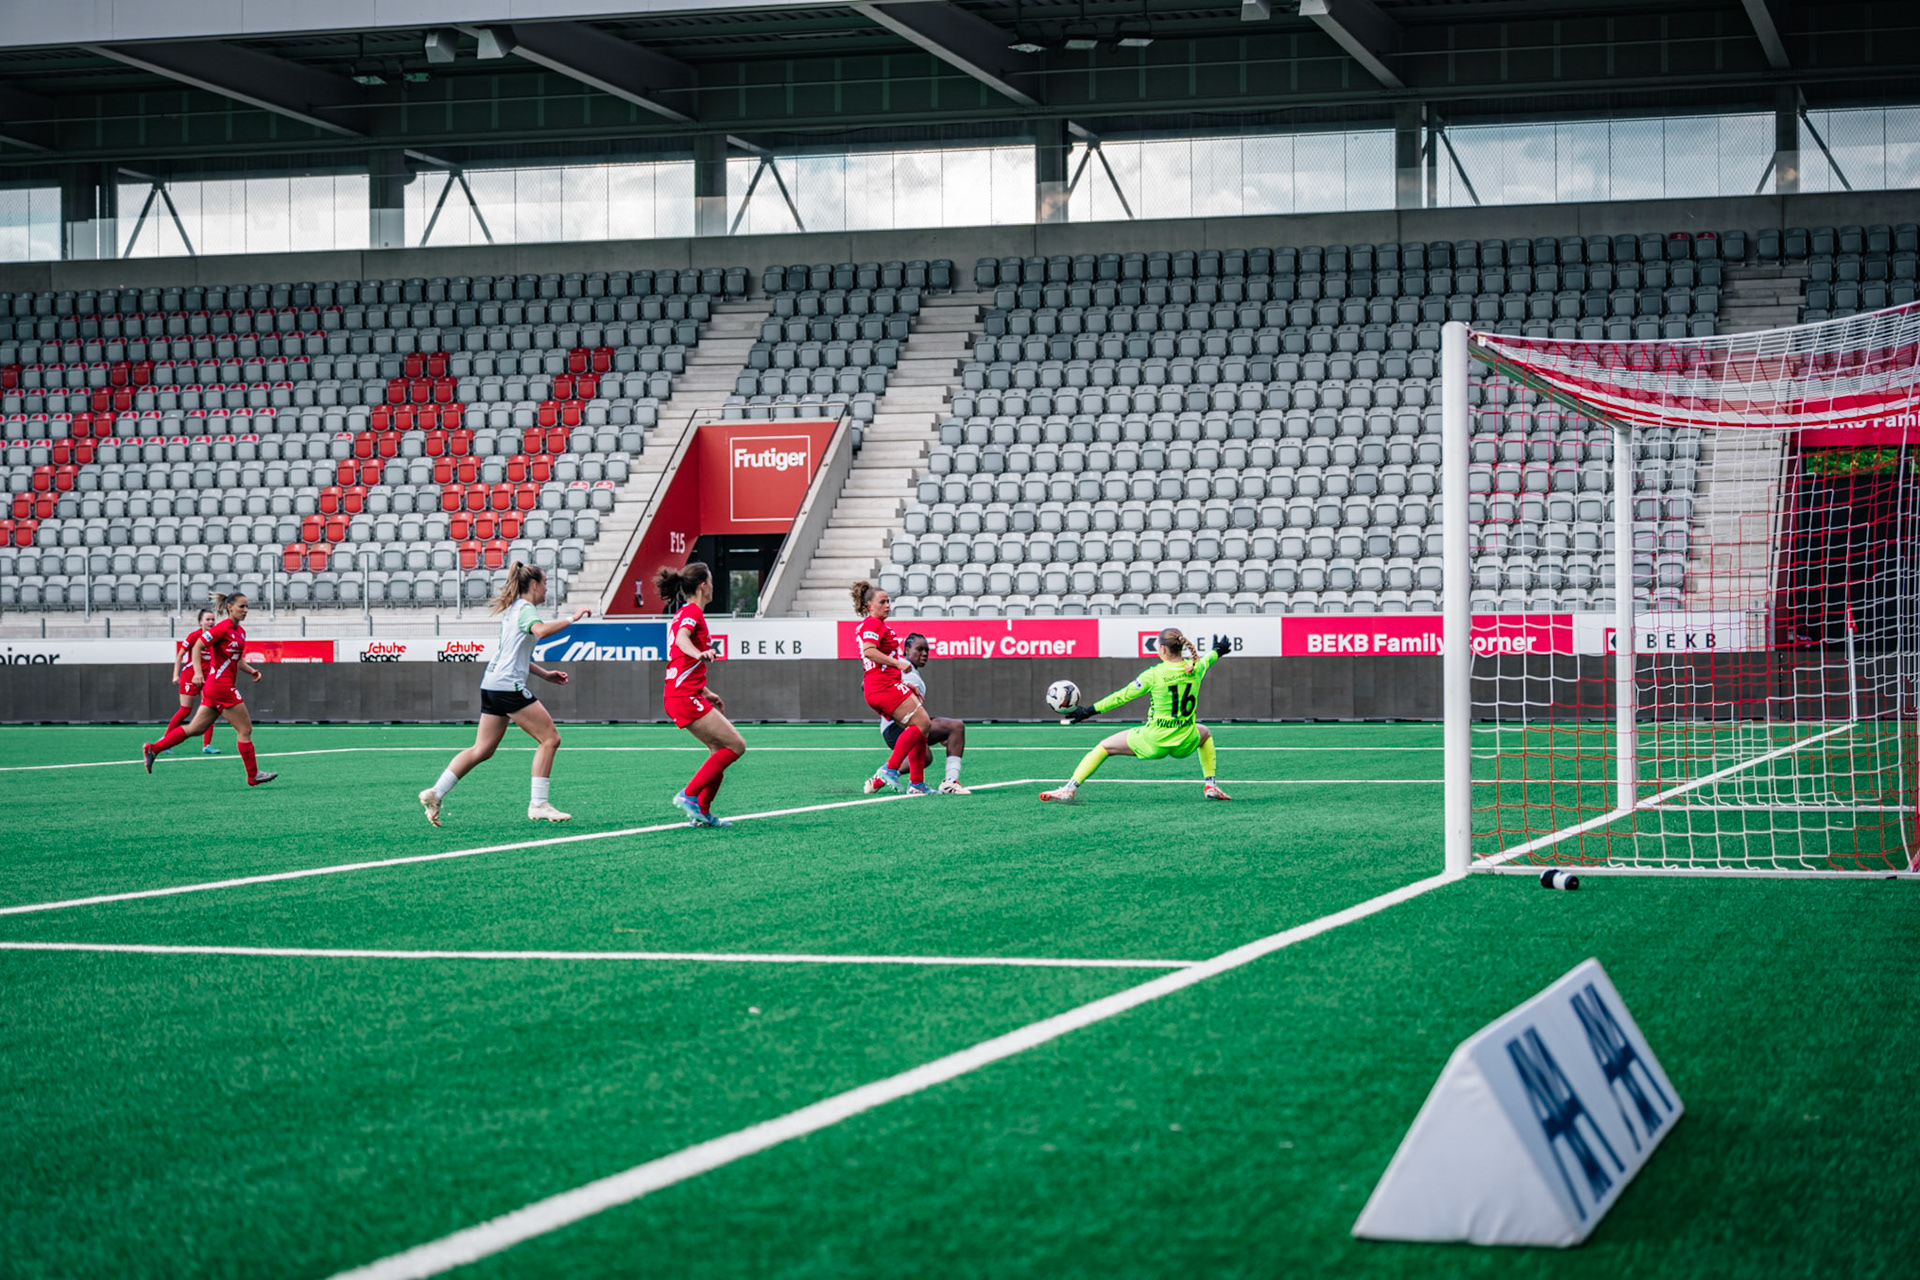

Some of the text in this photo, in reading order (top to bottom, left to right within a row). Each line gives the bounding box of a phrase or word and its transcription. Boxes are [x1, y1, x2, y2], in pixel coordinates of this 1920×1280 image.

[734, 448, 807, 471] Frutiger
[670, 531, 686, 553] F15
[366, 642, 407, 654] Schuhe
[444, 641, 485, 653] Schuhe
[741, 640, 802, 654] BEKB
[1000, 636, 1076, 655] Corner
[1307, 633, 1537, 655] BEKB Family orner
[1646, 633, 1716, 648] BEKB
[0, 646, 60, 664] ier
[693, 699, 704, 711] 3
[1168, 683, 1196, 718] 16
